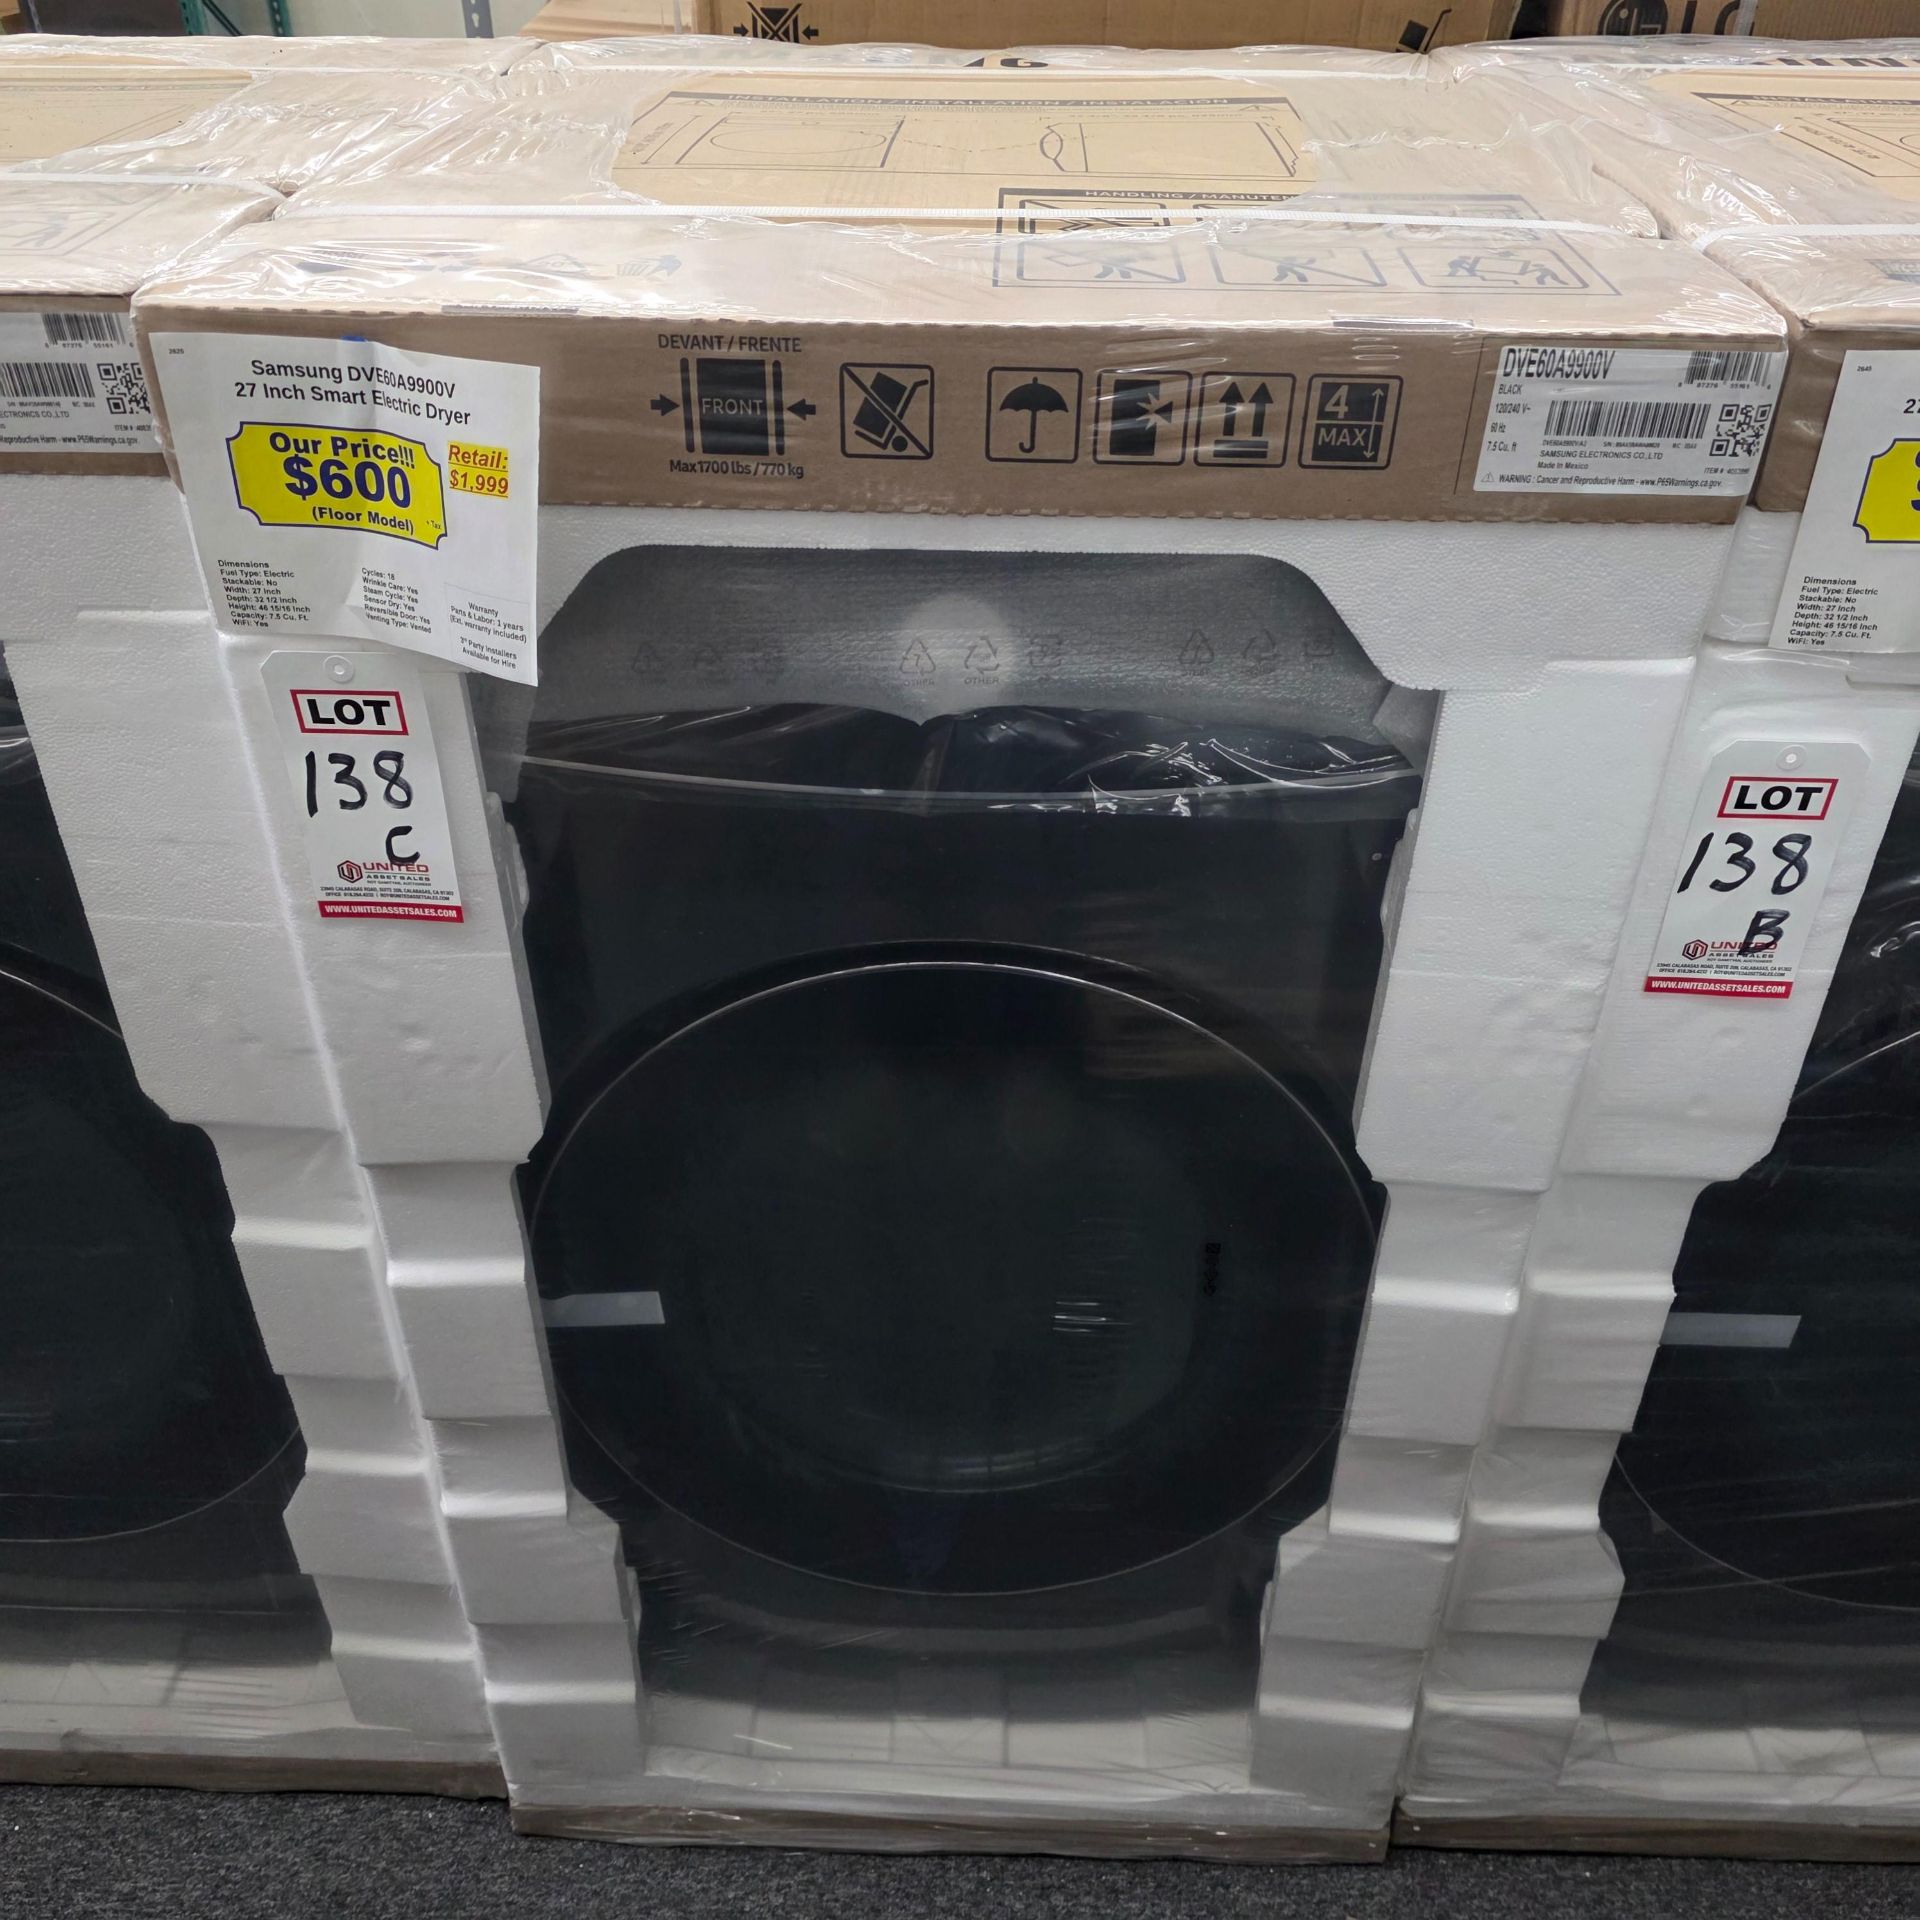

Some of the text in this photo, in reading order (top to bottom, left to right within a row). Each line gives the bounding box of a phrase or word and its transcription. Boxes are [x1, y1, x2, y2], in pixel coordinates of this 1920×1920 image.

[1085, 190, 1183, 199] HANDLING
[658, 333, 724, 350] DEVANT
[738, 336, 802, 353] FRENTE
[1502, 347, 1616, 380] DVE60A9900V
[251, 359, 456, 399] Samsung DVE60A9900V
[1498, 383, 1522, 395] BLACK
[234, 381, 472, 427] 27 Inch Smart Electric Dryer
[701, 397, 764, 416] FRONT
[1323, 385, 1350, 419] 4
[1317, 427, 1367, 446] MAX
[1499, 422, 1506, 433] Hz
[269, 431, 415, 469] Our Price!!!
[448, 444, 509, 470] Retail:
[1540, 450, 1578, 458] SAMSUNG
[1580, 450, 1632, 459] ELECTRONICS
[732, 461, 751, 475] lbs
[761, 463, 786, 476] 770
[788, 463, 804, 479] kg
[1538, 461, 1556, 469] Made
[1565, 462, 1589, 470] Mexico
[283, 453, 411, 510] $600
[449, 467, 510, 495] $1,999
[1499, 474, 1532, 484] WARNING
[1536, 475, 1559, 484] Cancer
[1560, 476, 1572, 484] and
[1574, 476, 1617, 486] Reproductive
[1618, 476, 1634, 486] Harm
[312, 505, 415, 536] (Floor Model)
[218, 560, 270, 568] Dimensions
[362, 567, 386, 579] Cycles:
[222, 578, 264, 586] Stackable:
[362, 576, 418, 595] Wrinkle Care: Yes
[1804, 576, 1856, 585] Dimensions
[224, 586, 250, 594] Width:
[363, 586, 418, 604] Steam Cycle: Yes
[1799, 595, 1842, 603] Stackable:
[1823, 586, 1845, 595] Type:
[364, 595, 415, 612] Sensor Dry: Yes
[468, 601, 498, 618] Warranty
[1797, 603, 1823, 611] Width:
[231, 611, 267, 620] Capacity:
[365, 604, 430, 624] Reversible Door: Yes
[366, 612, 431, 633] Venting Type: Vented
[474, 613, 495, 625] Labor:
[503, 622, 524, 632] years
[1794, 611, 1822, 620] Depth:
[465, 621, 491, 635] warranty
[493, 628, 527, 643] included)
[1790, 629, 1828, 638] Capacity:
[1792, 621, 1822, 629] Height:
[469, 639, 484, 652] Party
[463, 647, 489, 661] Available
[502, 660, 516, 669] Hire
[964, 676, 1000, 686] OTHER
[306, 698, 391, 726] LOT
[305, 750, 413, 818] 138
[1733, 785, 1824, 811] LOT
[386, 825, 420, 864] C
[362, 862, 429, 873] UNITED
[1676, 831, 1812, 896] 138
[325, 905, 457, 918] WWW.UNITEDASSETSALES.COM
[1736, 908, 1790, 956] B
[1652, 980, 1786, 993] WWW.UNITEDASSETSALES.COM
